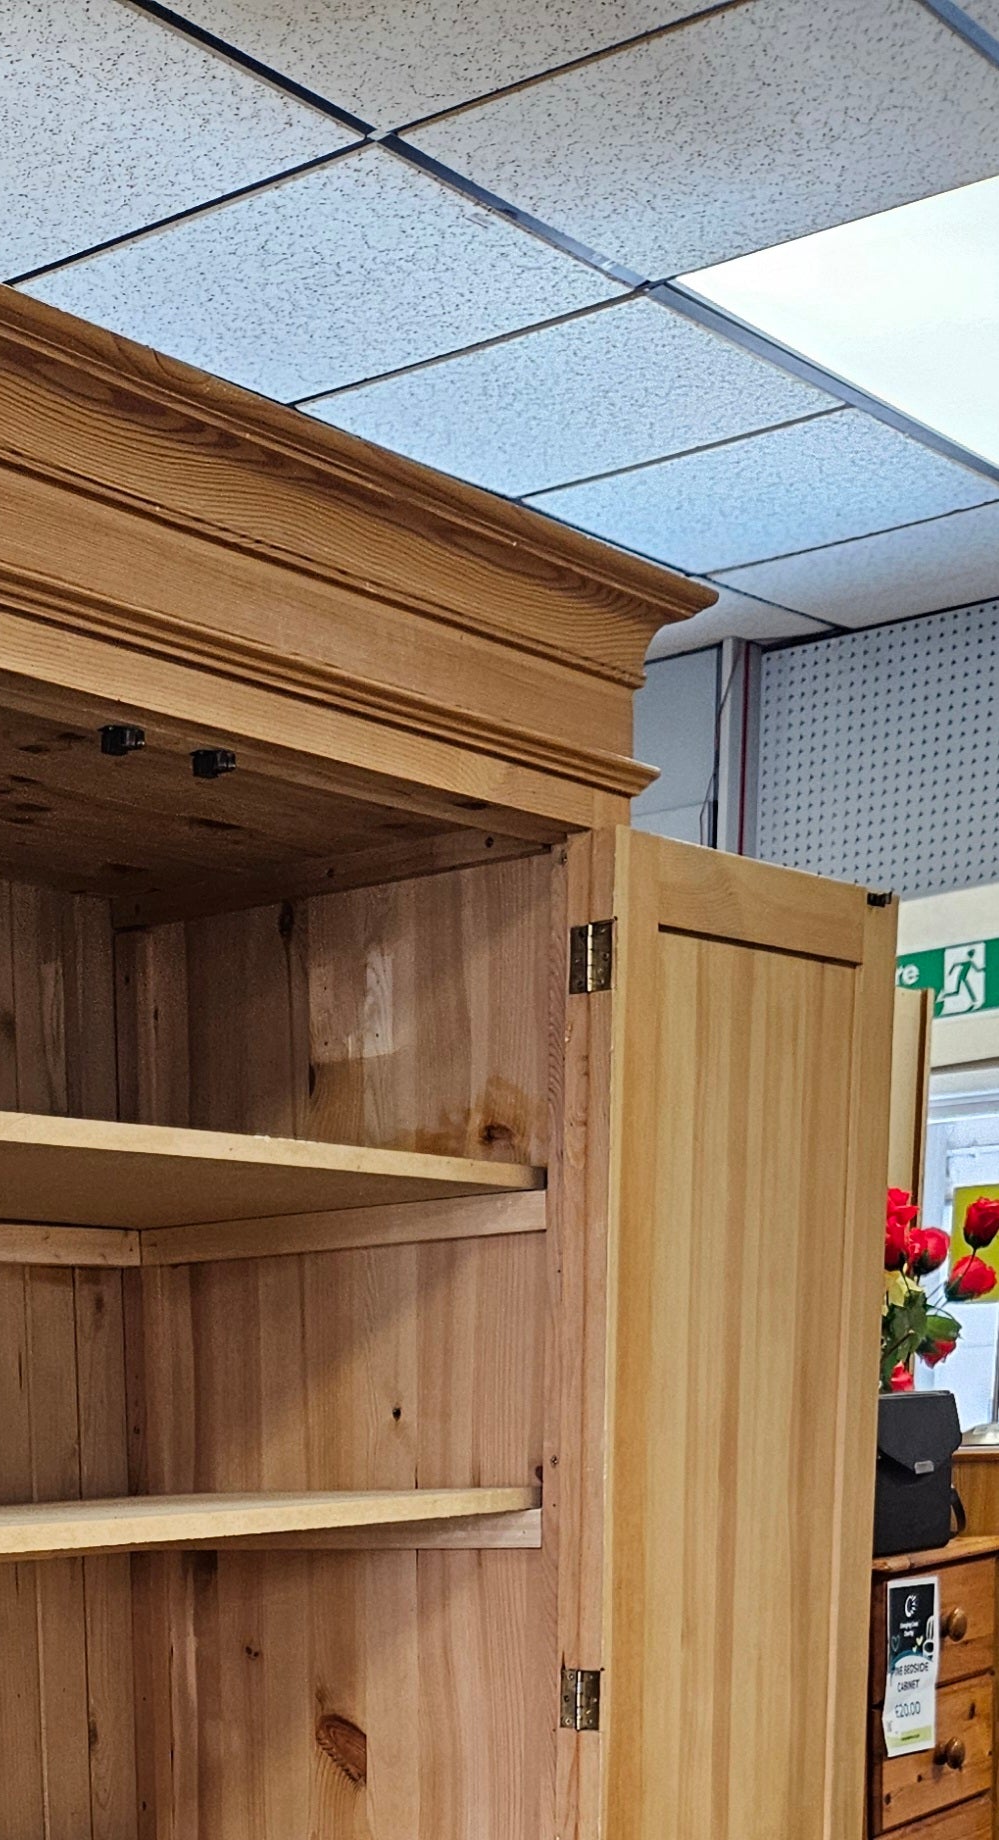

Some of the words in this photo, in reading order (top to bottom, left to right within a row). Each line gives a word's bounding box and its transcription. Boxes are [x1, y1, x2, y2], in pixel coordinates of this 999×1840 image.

[895, 964, 920, 986] re
[904, 1662, 929, 1675] BEDSIDE
[897, 1679, 920, 1693] CABINET
[895, 1701, 921, 1718] £20.00
